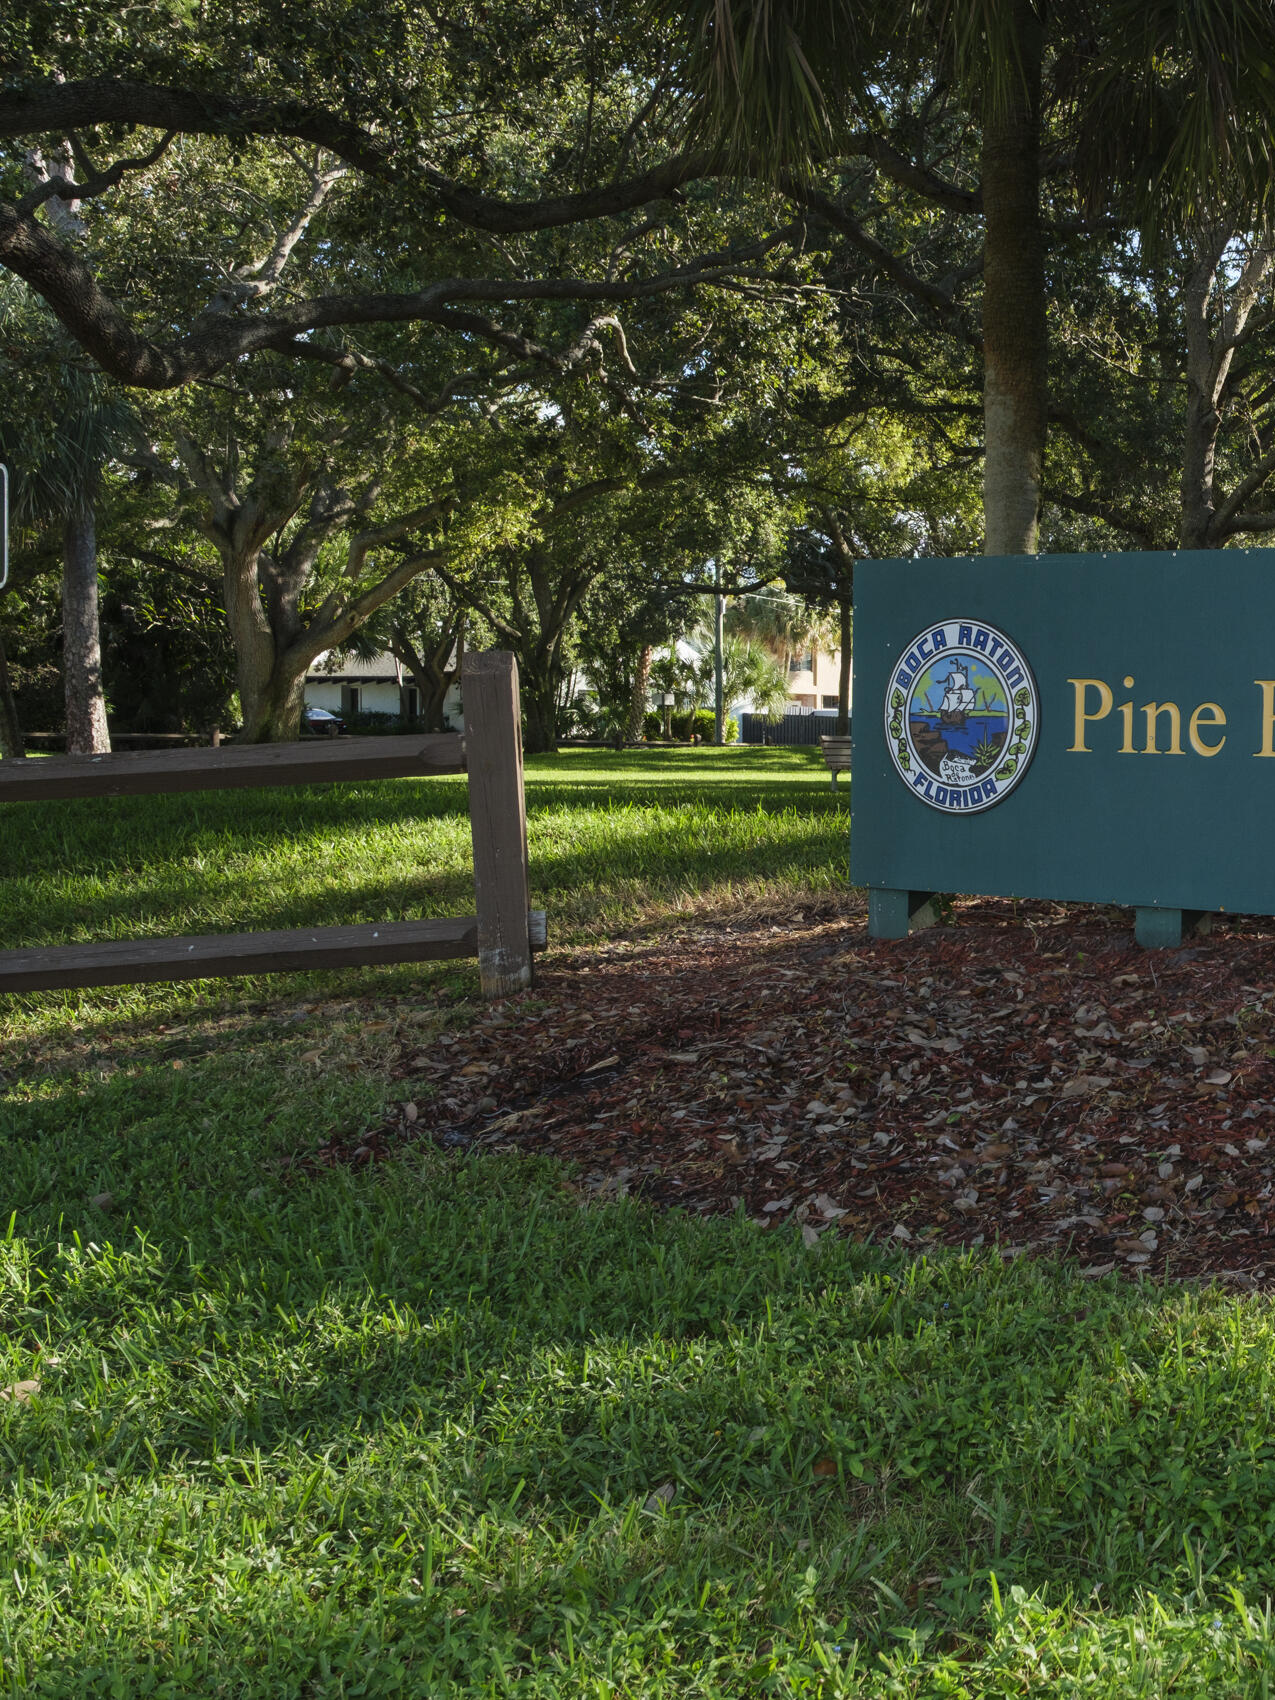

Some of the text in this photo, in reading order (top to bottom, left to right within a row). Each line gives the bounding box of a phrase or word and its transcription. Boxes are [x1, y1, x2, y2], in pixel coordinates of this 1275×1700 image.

[896, 625, 1026, 691] BOCA RATON
[1066, 676, 1227, 758] Pine
[913, 772, 998, 808] FLORIDA
